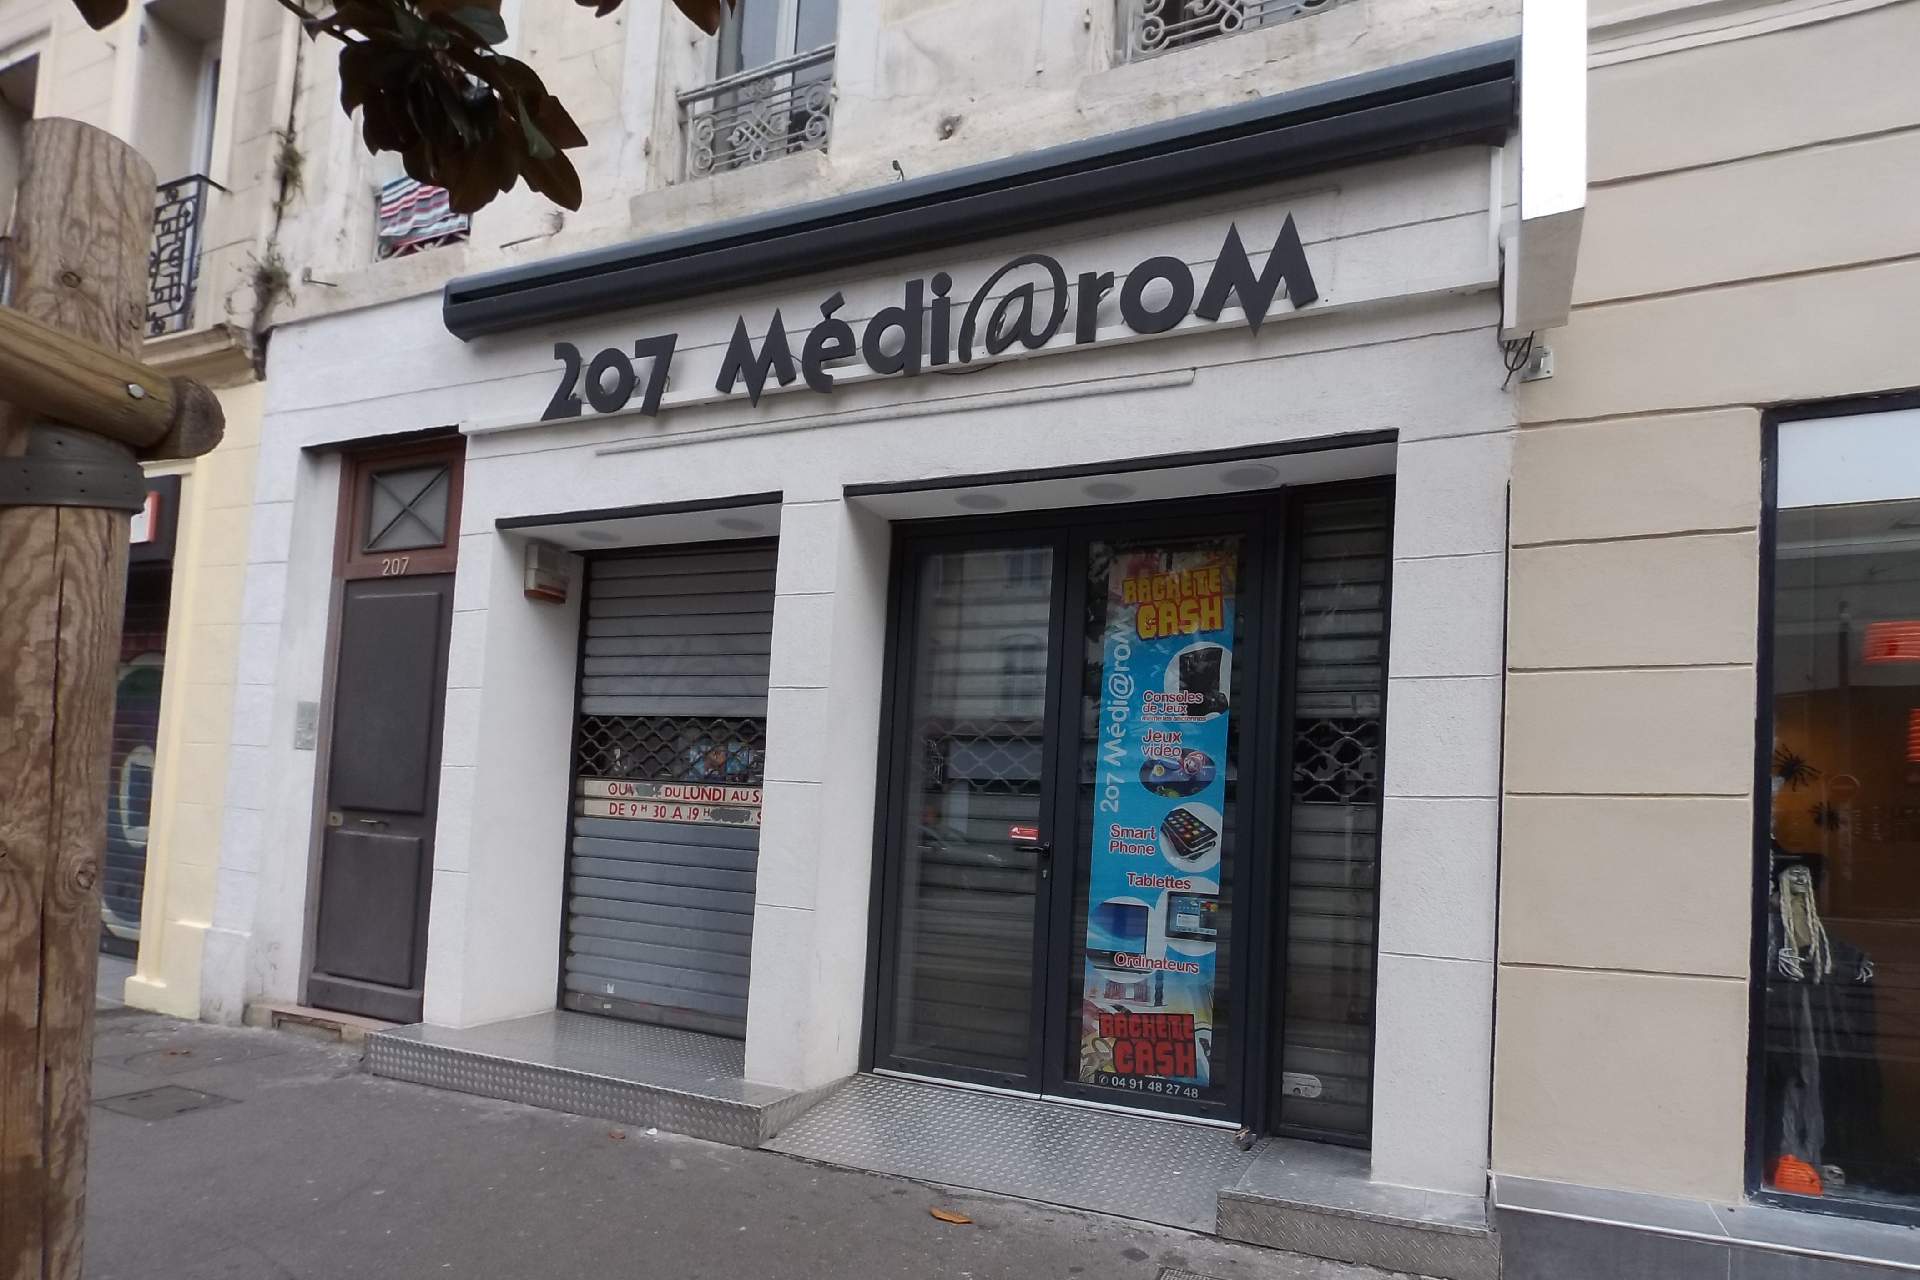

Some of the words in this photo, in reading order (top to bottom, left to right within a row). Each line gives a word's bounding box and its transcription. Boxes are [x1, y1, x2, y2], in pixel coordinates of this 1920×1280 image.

[541, 333, 678, 421] 207
[715, 211, 1320, 409] Médi@roM
[382, 556, 410, 576] 207
[1136, 595, 1224, 640] CASH
[1142, 690, 1203, 705] Consoles
[1142, 703, 1158, 714] de
[1159, 704, 1188, 715] Jeux
[1142, 728, 1182, 744] Jeux
[664, 786, 681, 799] DU
[683, 786, 726, 802] LUNDI
[731, 790, 750, 801] AU
[1100, 772, 1125, 813] 207
[609, 802, 625, 815] DE
[1110, 824, 1157, 840] Smart
[1109, 840, 1155, 856] Phone
[1127, 872, 1191, 890] Tablettes
[1114, 952, 1200, 974] Ordinateurs
[1114, 1040, 1197, 1079] CASH
[1111, 1075, 1126, 1088] 04
[1129, 1078, 1143, 1090] 91
[1147, 1080, 1162, 1093] 48
[1165, 1083, 1180, 1096] 27
[1183, 1086, 1198, 1099] 48
